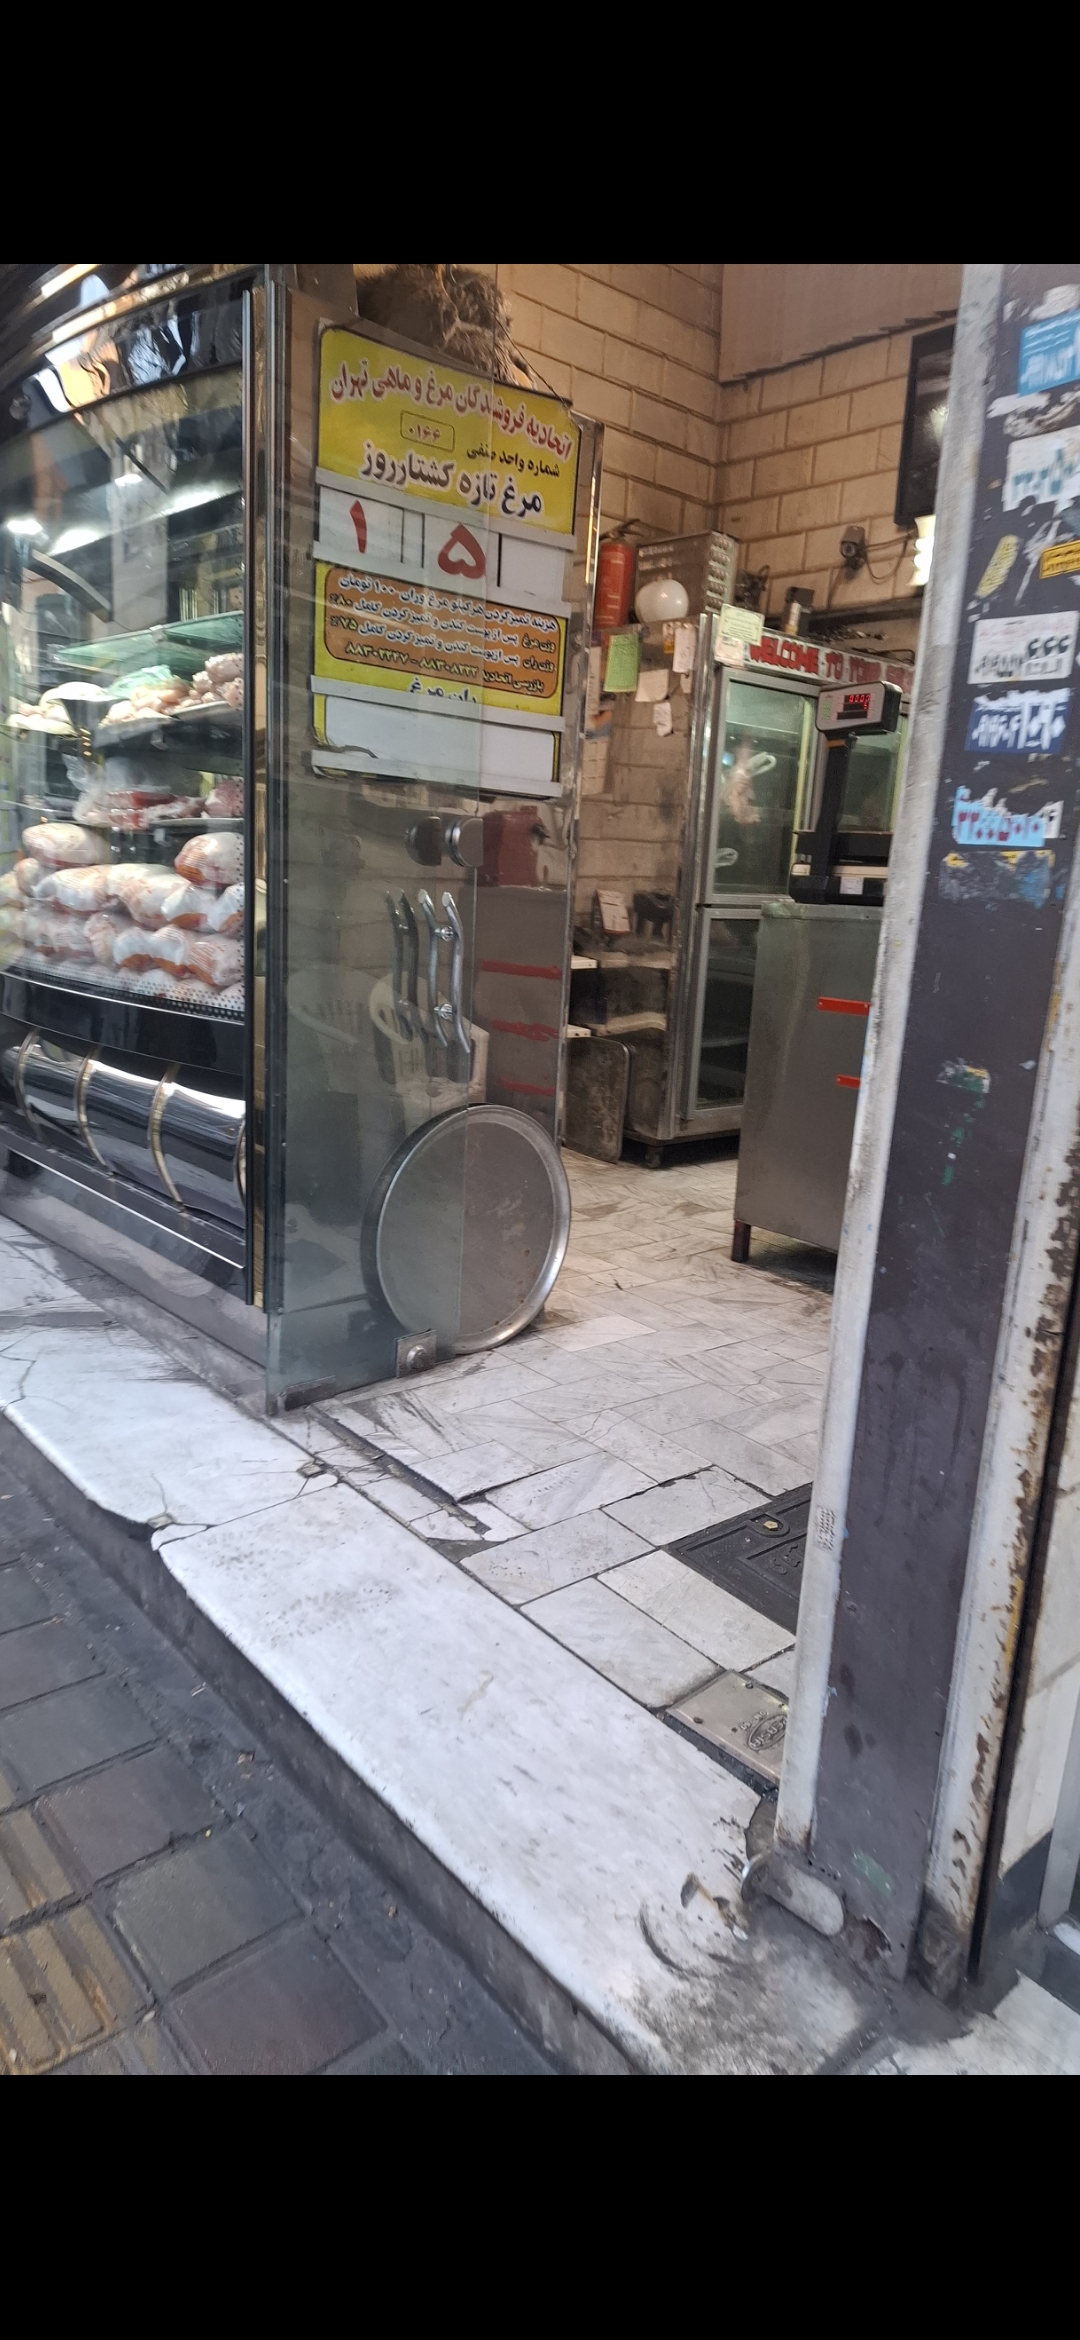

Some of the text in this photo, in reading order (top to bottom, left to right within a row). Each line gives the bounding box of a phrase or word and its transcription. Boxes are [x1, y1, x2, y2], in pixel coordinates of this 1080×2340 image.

[331, 360, 572, 460] اتحادیه فروشندگان مرغ و ماهی تهران
[466, 443, 560, 478] شماره واحد صنفی
[458, 472, 497, 506] تازه
[501, 477, 542, 518] مرغ
[437, 524, 486, 579] ۵
[339, 574, 371, 592] تومان
[375, 580, 394, 593] ۱۰۰
[354, 598, 381, 612] کامل
[428, 591, 448, 607] مرغ
[382, 608, 408, 621] کردن
[410, 612, 431, 624] تمیز
[359, 621, 385, 635] کامل
[440, 620, 464, 631] کندن
[530, 615, 556, 632] هزینه
[386, 630, 413, 644] کردن
[413, 634, 436, 646] تمیز
[502, 634, 518, 646] پس
[522, 633, 539, 649] مرغ
[445, 641, 469, 652] کندن
[540, 639, 556, 653] وزن
[503, 654, 519, 666] پس
[523, 656, 537, 670] ران
[539, 660, 555, 672] وزن
